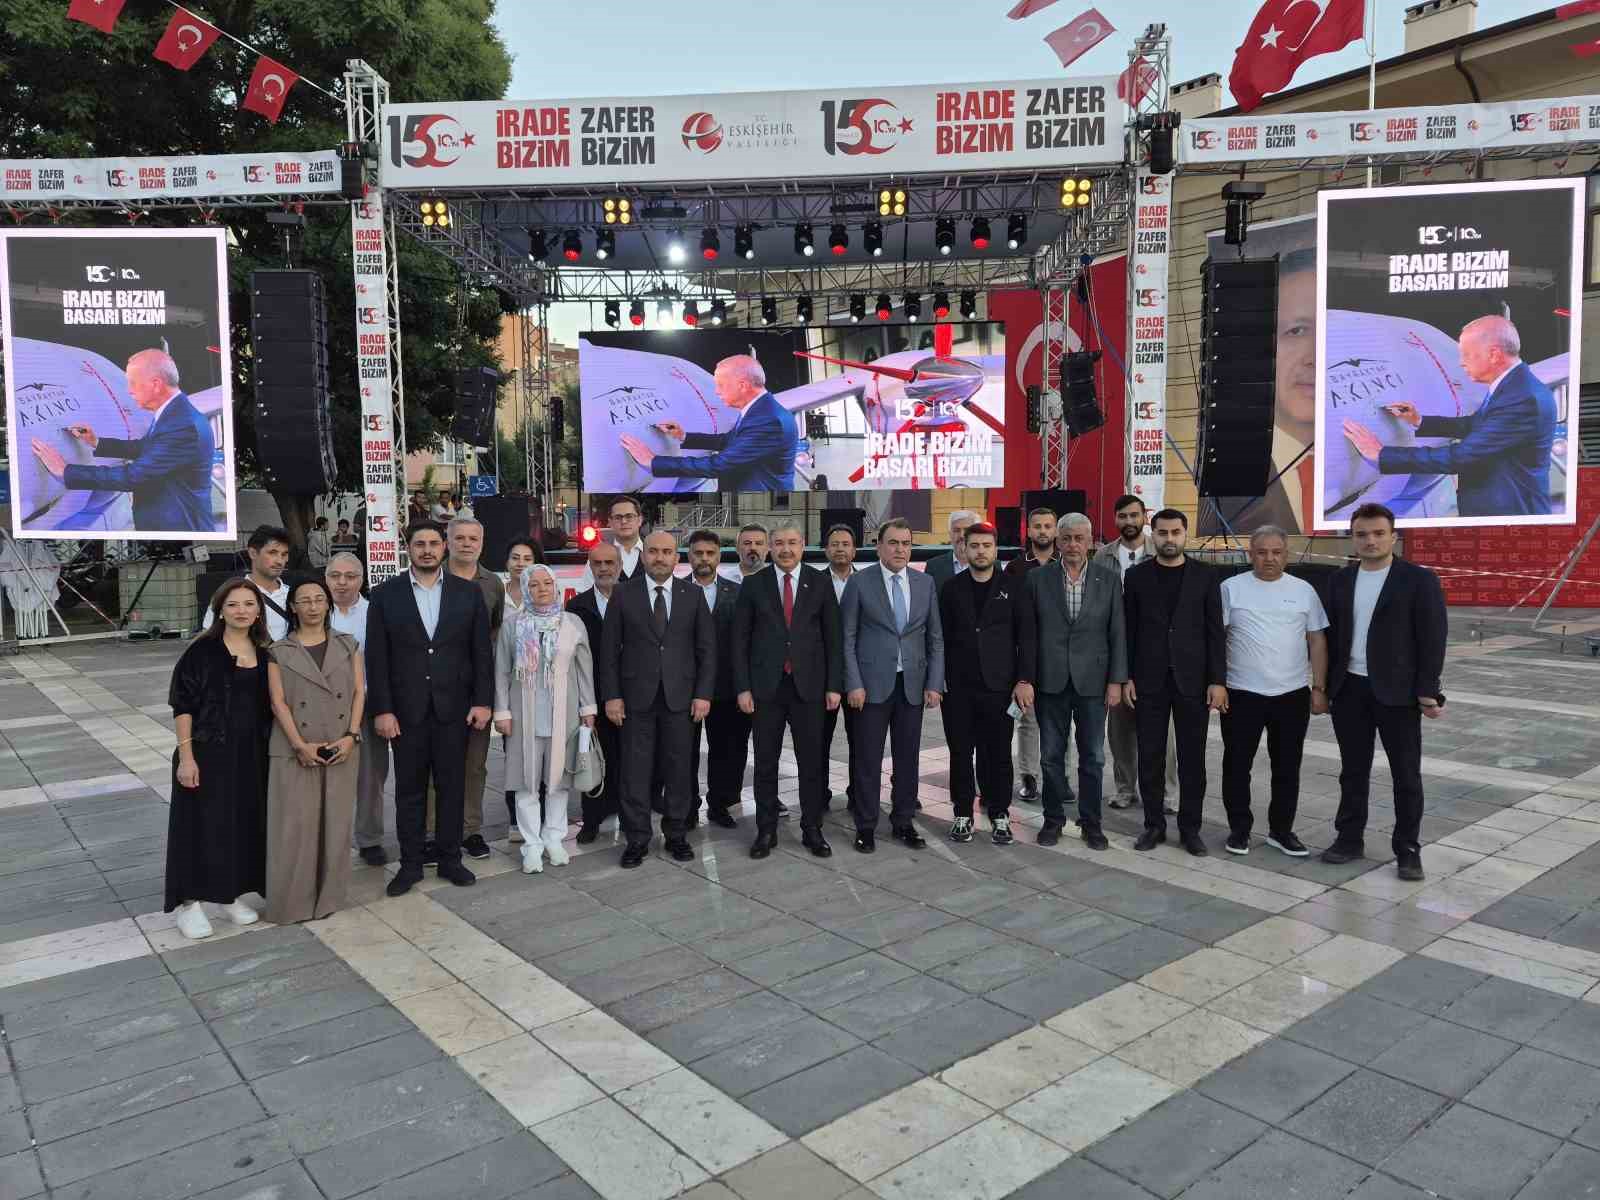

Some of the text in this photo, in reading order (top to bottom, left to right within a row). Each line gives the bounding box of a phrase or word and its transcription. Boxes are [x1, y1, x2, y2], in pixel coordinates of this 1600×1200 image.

[936, 89, 1015, 122] İRADE
[1026, 86, 1105, 116] ZAFER
[496, 108, 570, 137] İRADE
[581, 106, 655, 133] ZAFER
[1026, 117, 1105, 150] BİZİM
[581, 136, 655, 166] BİZİM
[936, 122, 1014, 155] BİZİM
[497, 140, 570, 168] BİZİM
[1389, 250, 1509, 275] İRADE BİZİM
[63, 290, 165, 308] İRADE BİZİM
